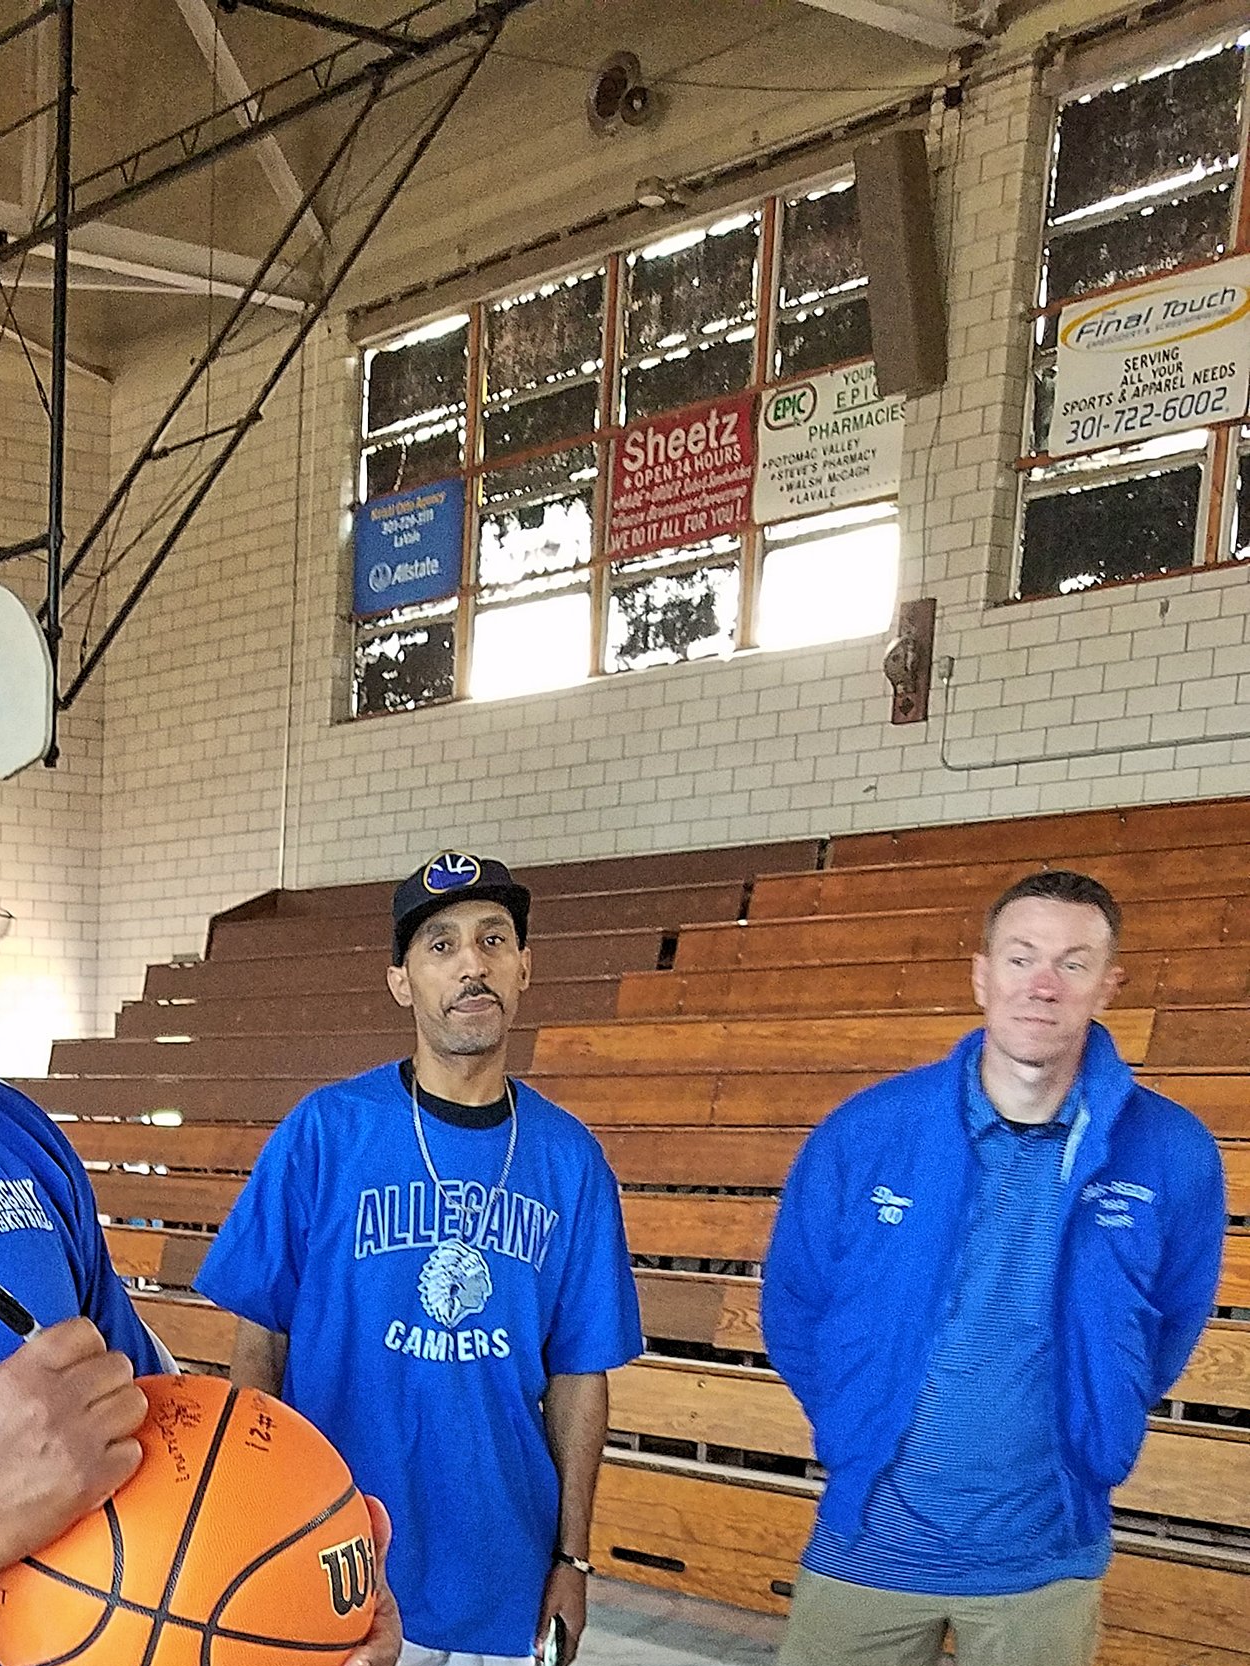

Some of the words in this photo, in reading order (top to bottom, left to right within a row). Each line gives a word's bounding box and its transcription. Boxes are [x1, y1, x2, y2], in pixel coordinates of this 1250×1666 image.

[1075, 307, 1153, 343] Final
[1161, 286, 1237, 320] Touch
[1120, 372, 1144, 388] ALL
[1151, 361, 1183, 378] YOUR
[1124, 346, 1180, 373] SERVING
[773, 391, 808, 422] EPIC
[1062, 391, 1113, 417] SPORTS
[1117, 388, 1127, 405] &
[1130, 375, 1186, 401] APPAREL
[1192, 362, 1236, 386] NEEDS
[808, 401, 907, 442] PHARMACIES
[1066, 386, 1228, 444] 301-722-6002
[622, 408, 738, 472] Sheetz
[768, 447, 818, 469] POTOMAC
[822, 438, 860, 457] VALLEY
[634, 463, 673, 487] OPEN
[676, 458, 693, 478] 24
[694, 444, 741, 472] HOURS
[776, 462, 819, 481] STEVE'S
[822, 448, 877, 469] PHARMACY
[786, 477, 823, 493] WALSH
[610, 530, 631, 551] WE
[647, 522, 659, 544] IT
[660, 517, 682, 541] ALL
[684, 511, 707, 534] FOR
[391, 556, 440, 585] Allstate
[354, 1179, 560, 1273] ALLEGANY
